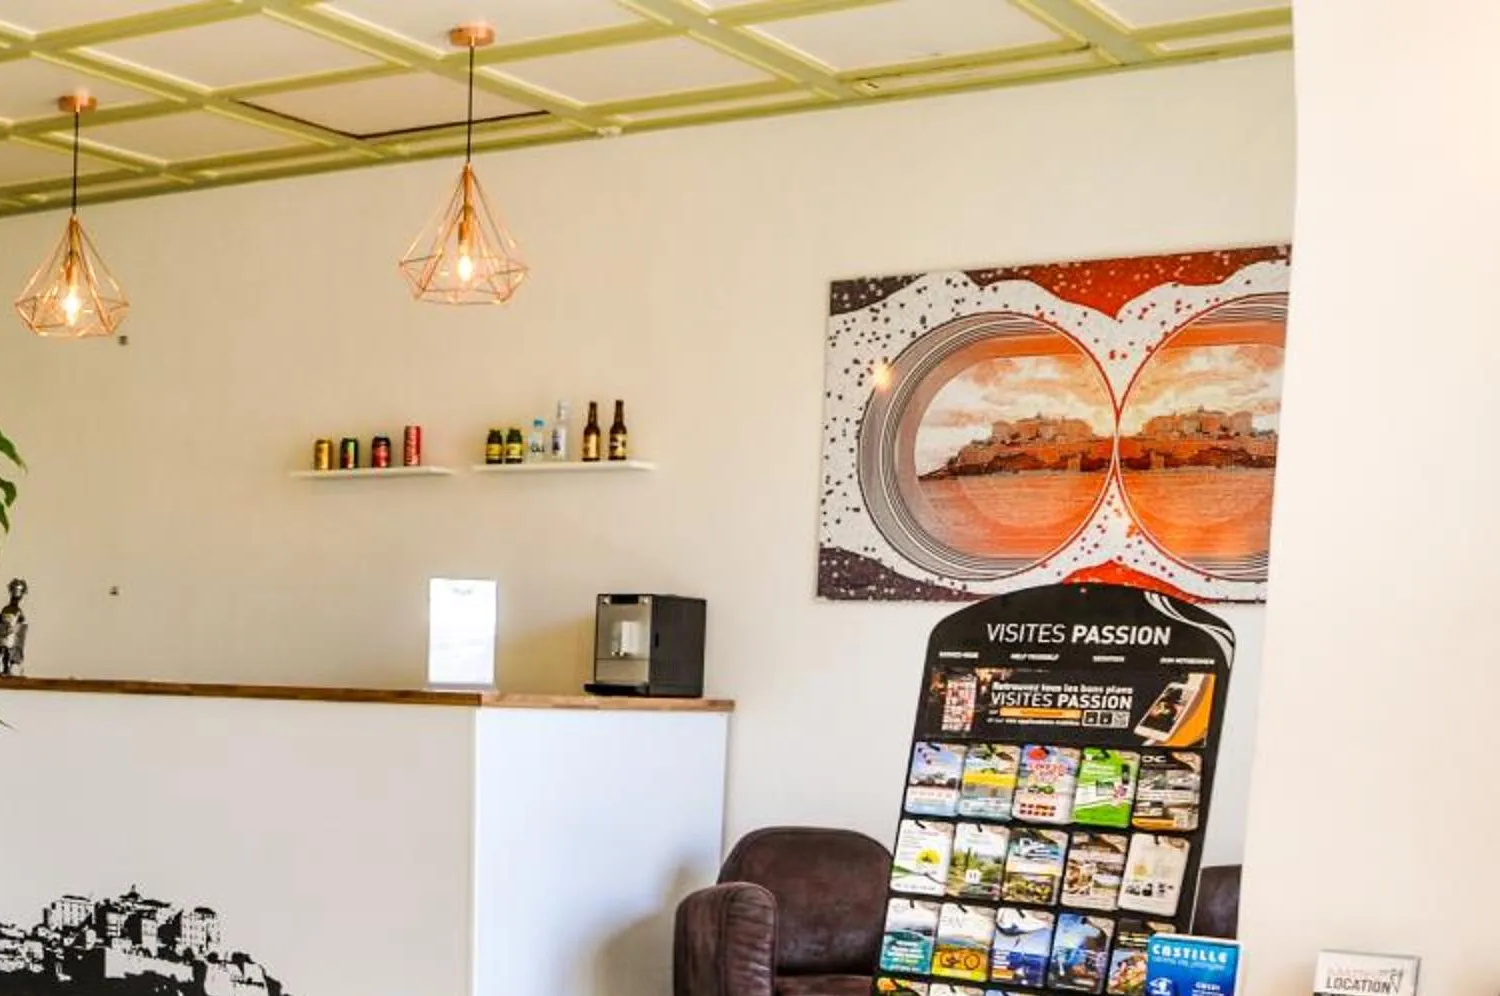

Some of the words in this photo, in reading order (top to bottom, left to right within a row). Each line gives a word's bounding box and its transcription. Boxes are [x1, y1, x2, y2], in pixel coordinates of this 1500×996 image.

[986, 622, 1066, 644] VISITES
[1070, 624, 1172, 646] PASSION
[990, 691, 1054, 707] VISITES
[1056, 693, 1134, 711] PASSION
